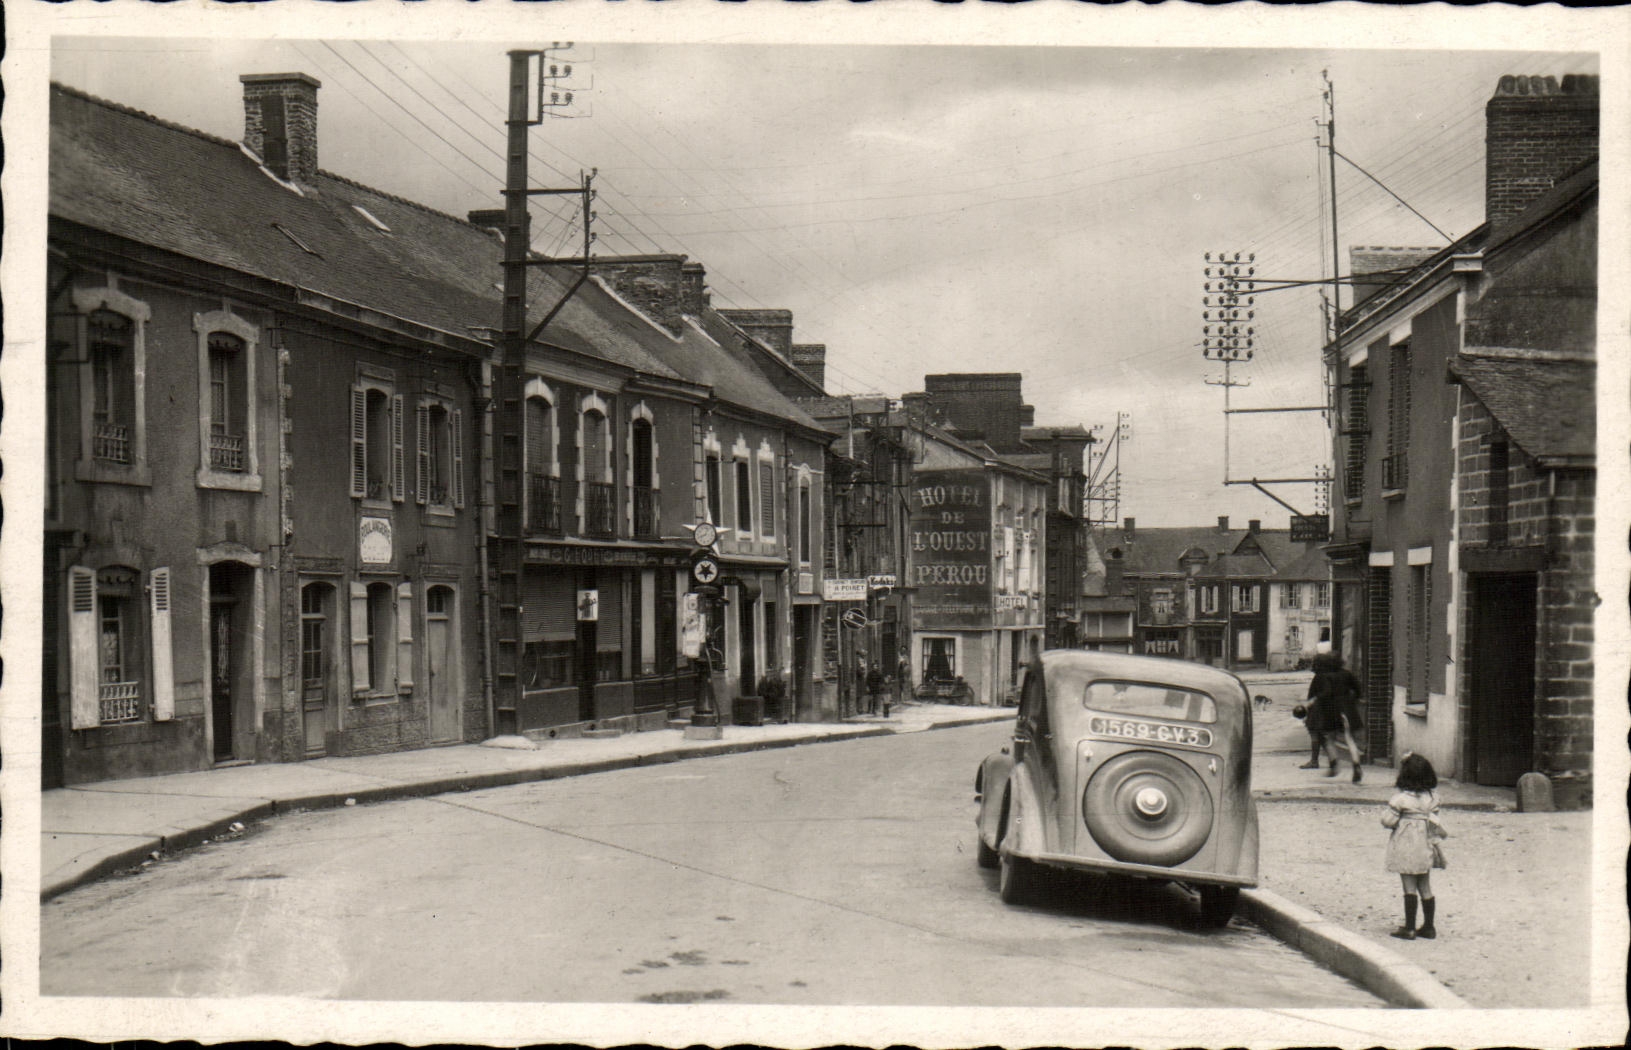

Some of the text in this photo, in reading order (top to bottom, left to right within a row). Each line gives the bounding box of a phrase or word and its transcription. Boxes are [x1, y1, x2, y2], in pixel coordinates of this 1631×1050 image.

[918, 485, 982, 507] HOTEL
[941, 511, 965, 524] DE
[913, 531, 989, 551] L'OUEST
[916, 564, 987, 585] PEROU
[1000, 597, 1025, 606] HOTEL
